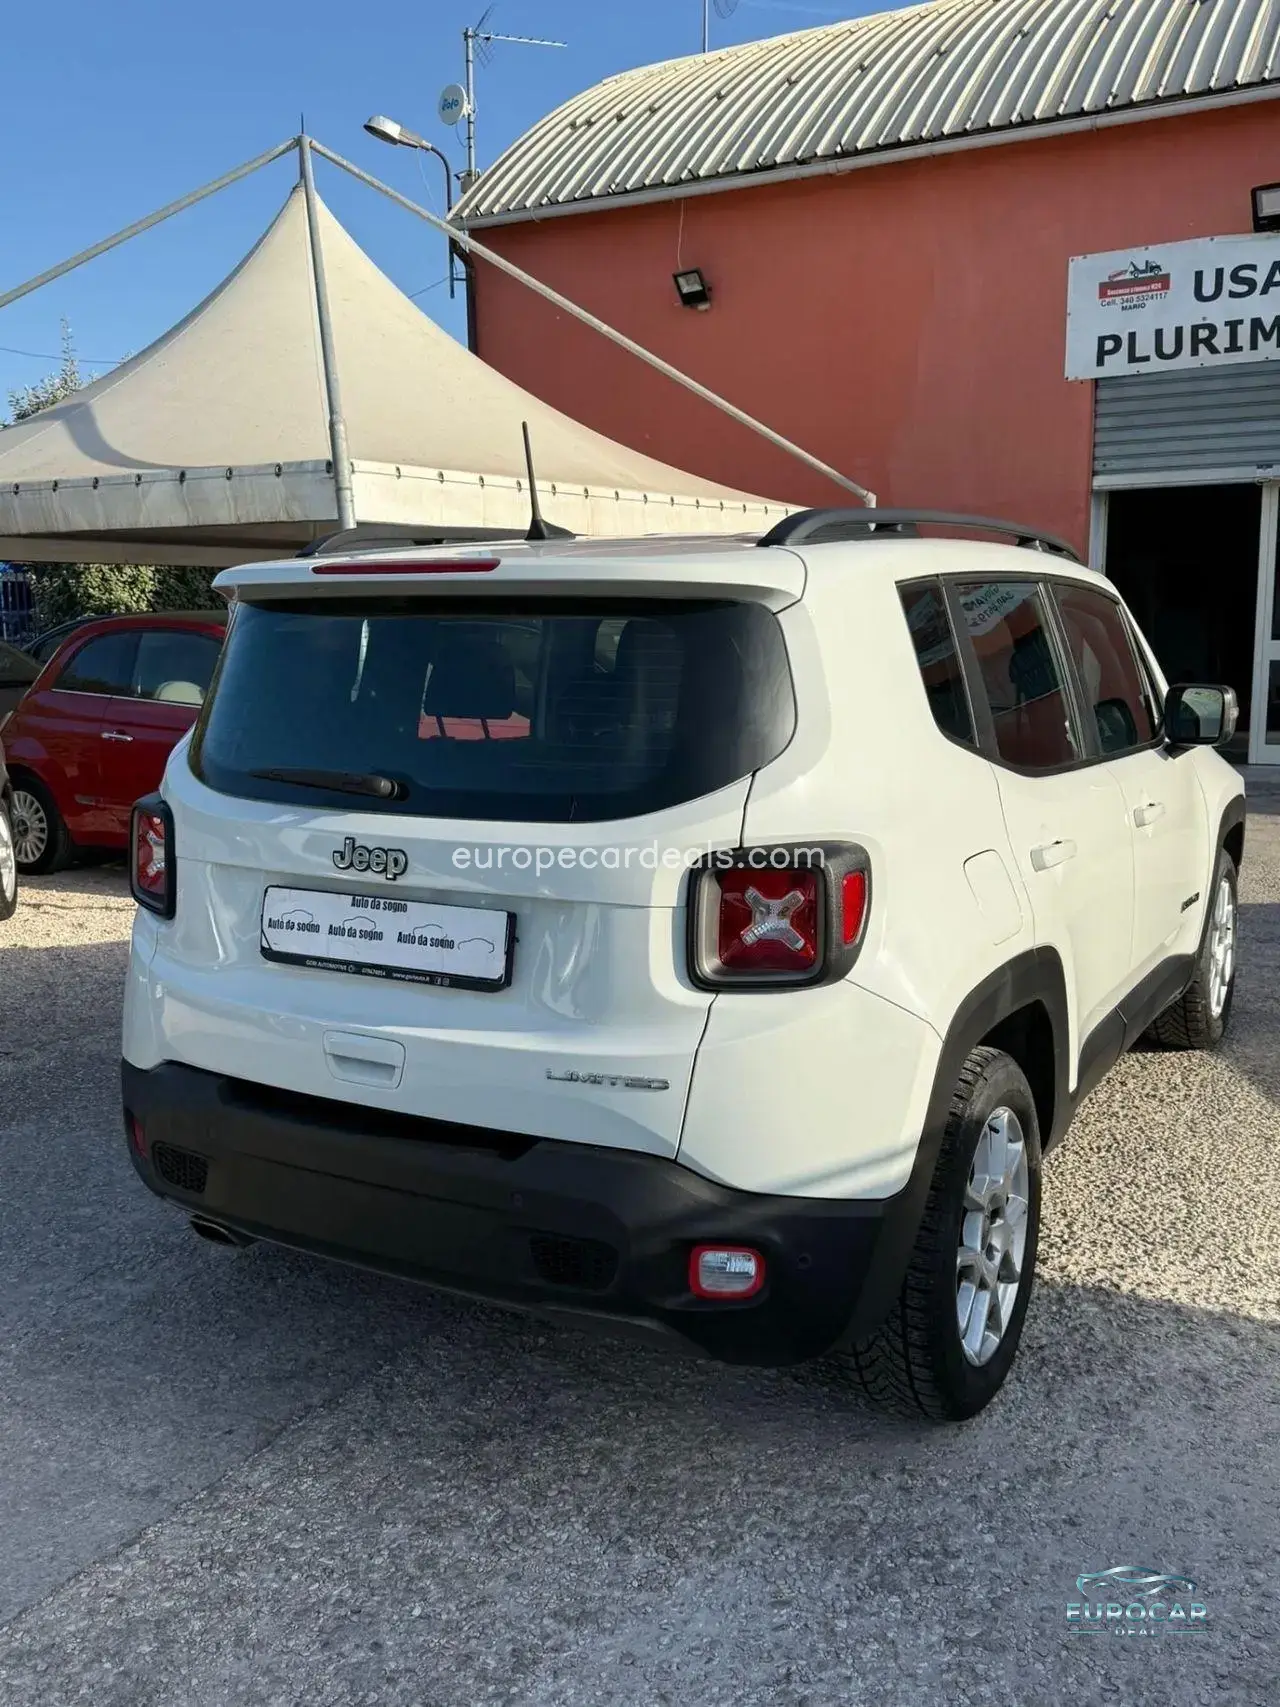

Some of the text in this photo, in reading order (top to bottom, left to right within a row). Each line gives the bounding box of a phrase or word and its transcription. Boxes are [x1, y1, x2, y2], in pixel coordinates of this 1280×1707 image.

[1121, 302, 1146, 312] MARIO
[333, 837, 408, 880] Jeep
[351, 896, 408, 913] Auto da sogno
[268, 917, 285, 930] Auto
[285, 920, 296, 931] da
[328, 924, 384, 941] Auto da sogno
[397, 931, 416, 945] Auto
[417, 934, 429, 946] da
[546, 1067, 670, 1090] LIMITED
